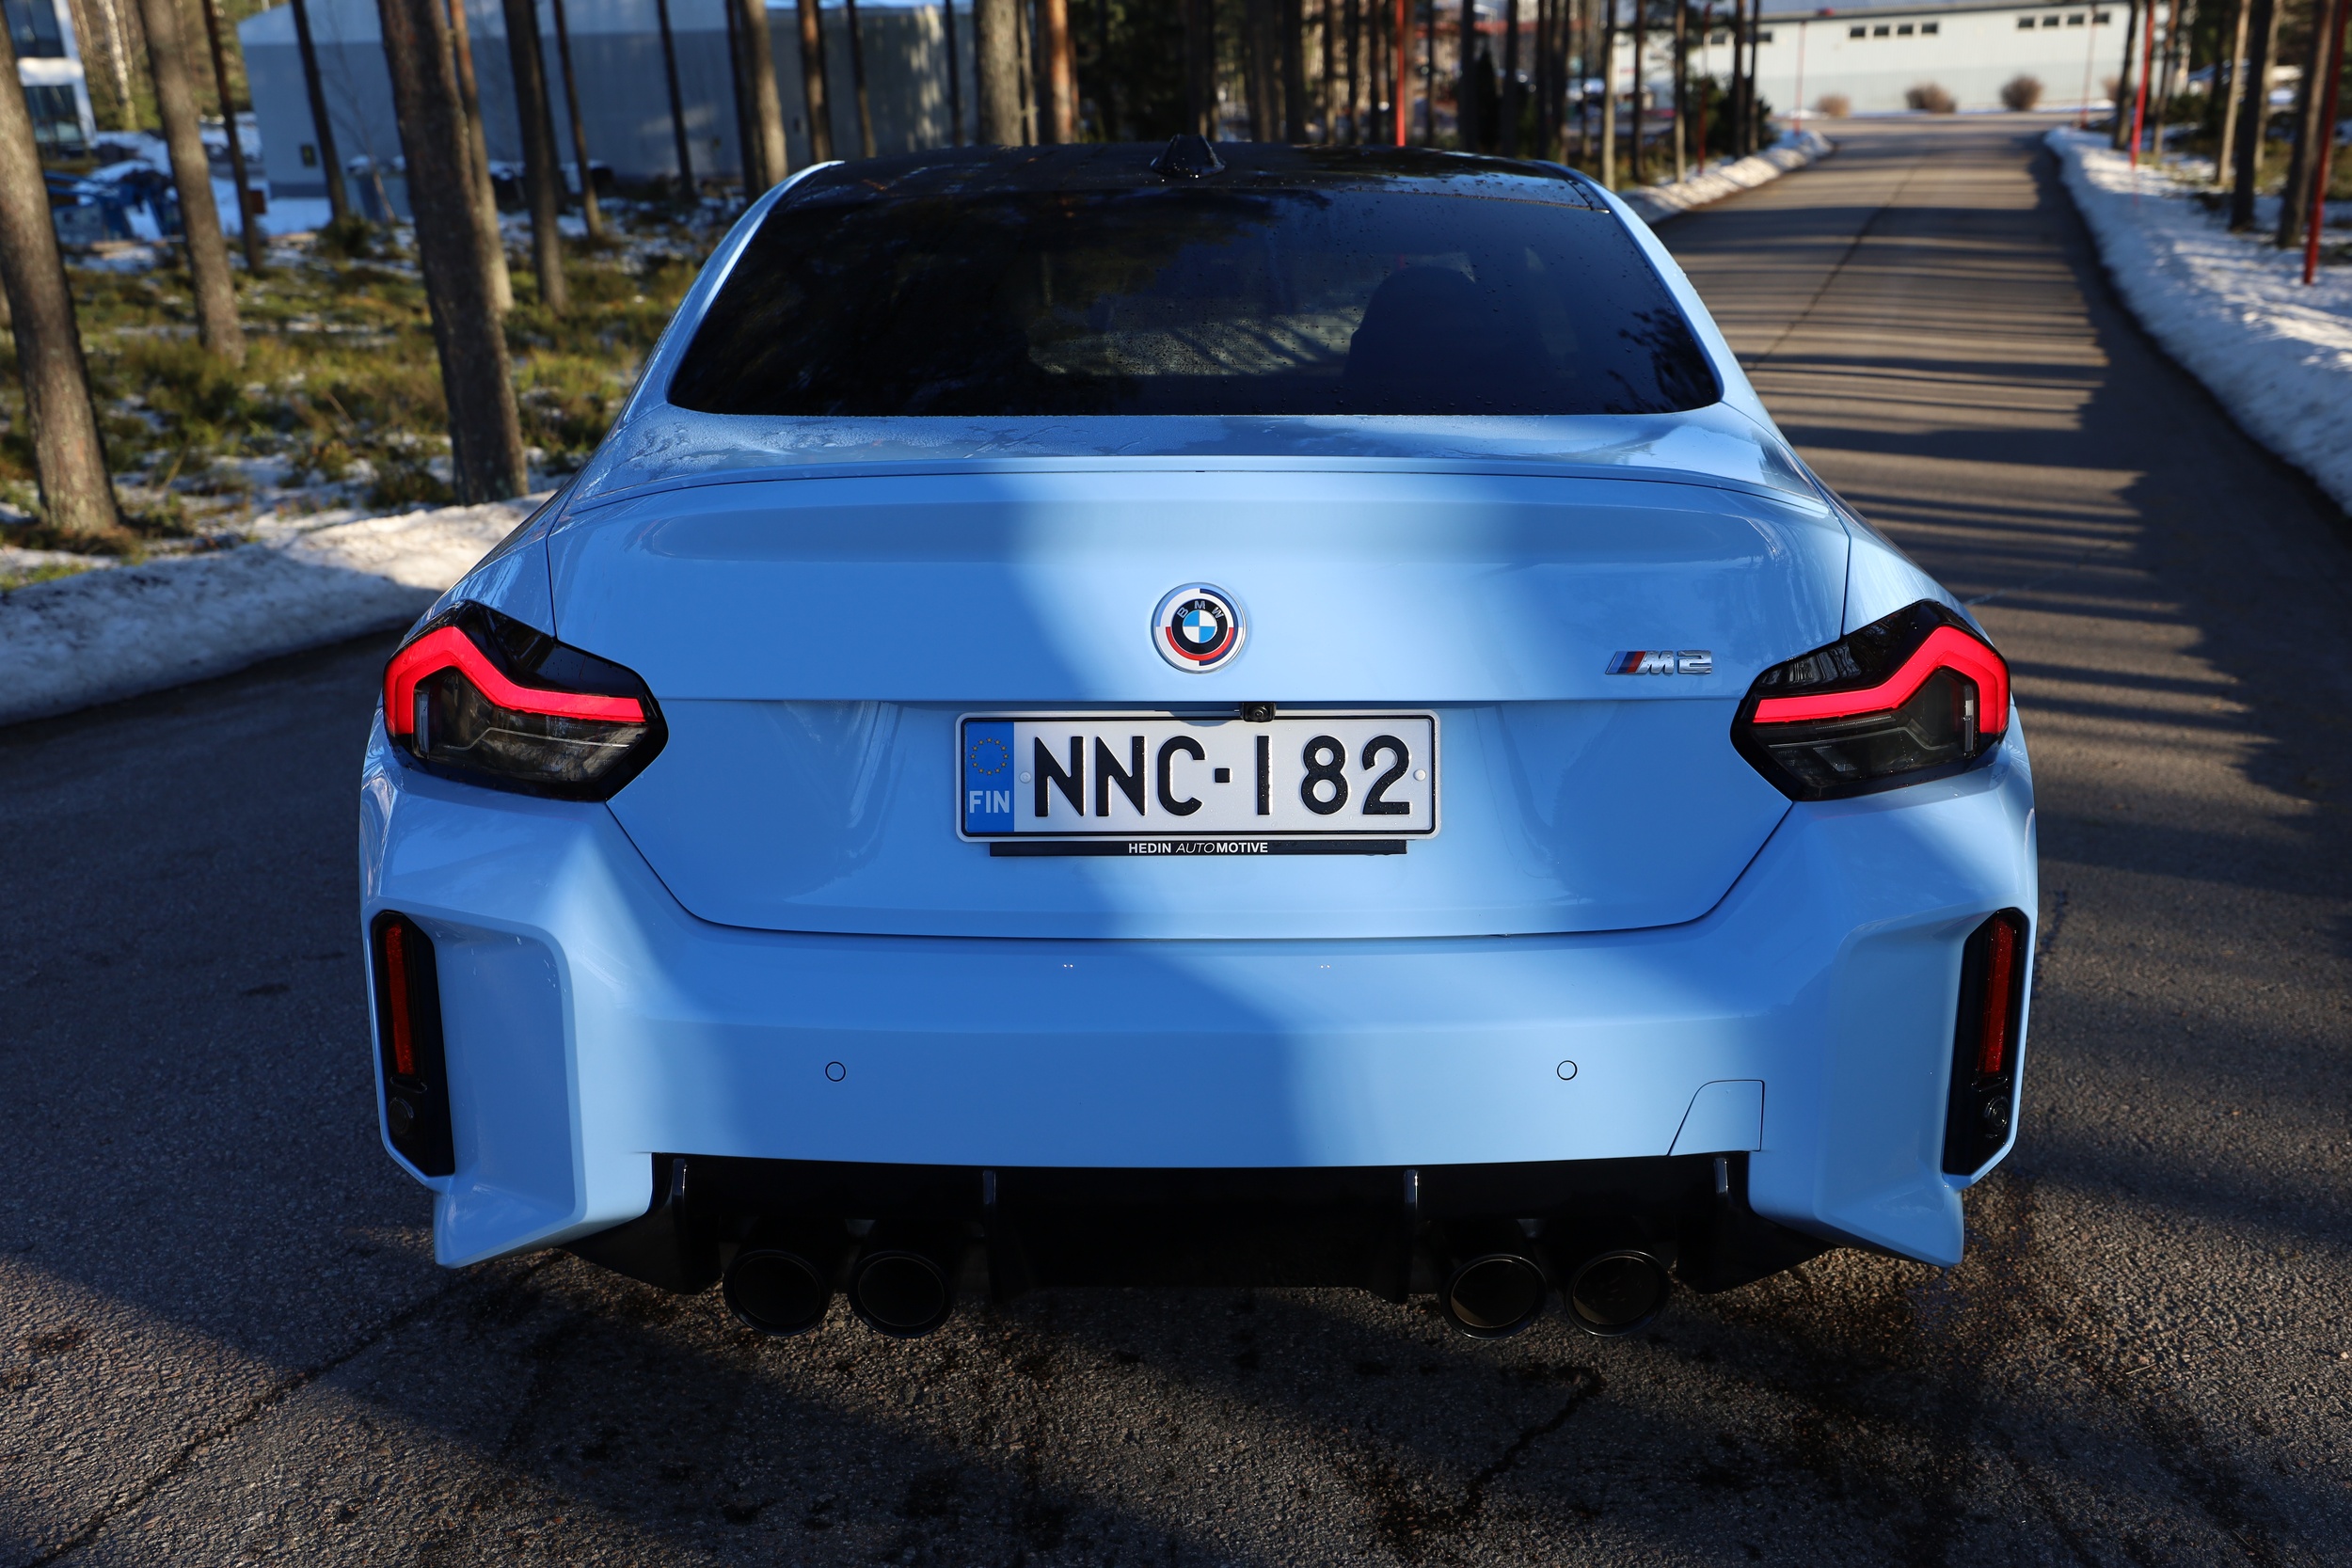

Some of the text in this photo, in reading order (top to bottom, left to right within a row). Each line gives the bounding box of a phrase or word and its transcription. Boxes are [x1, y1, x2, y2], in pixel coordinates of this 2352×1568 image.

[1176, 600, 1224, 619] BMW
[1634, 650, 1712, 674] M2
[969, 790, 1010, 814] FIN
[1128, 842, 1268, 854] HEDIN AUTOMOTIVE
